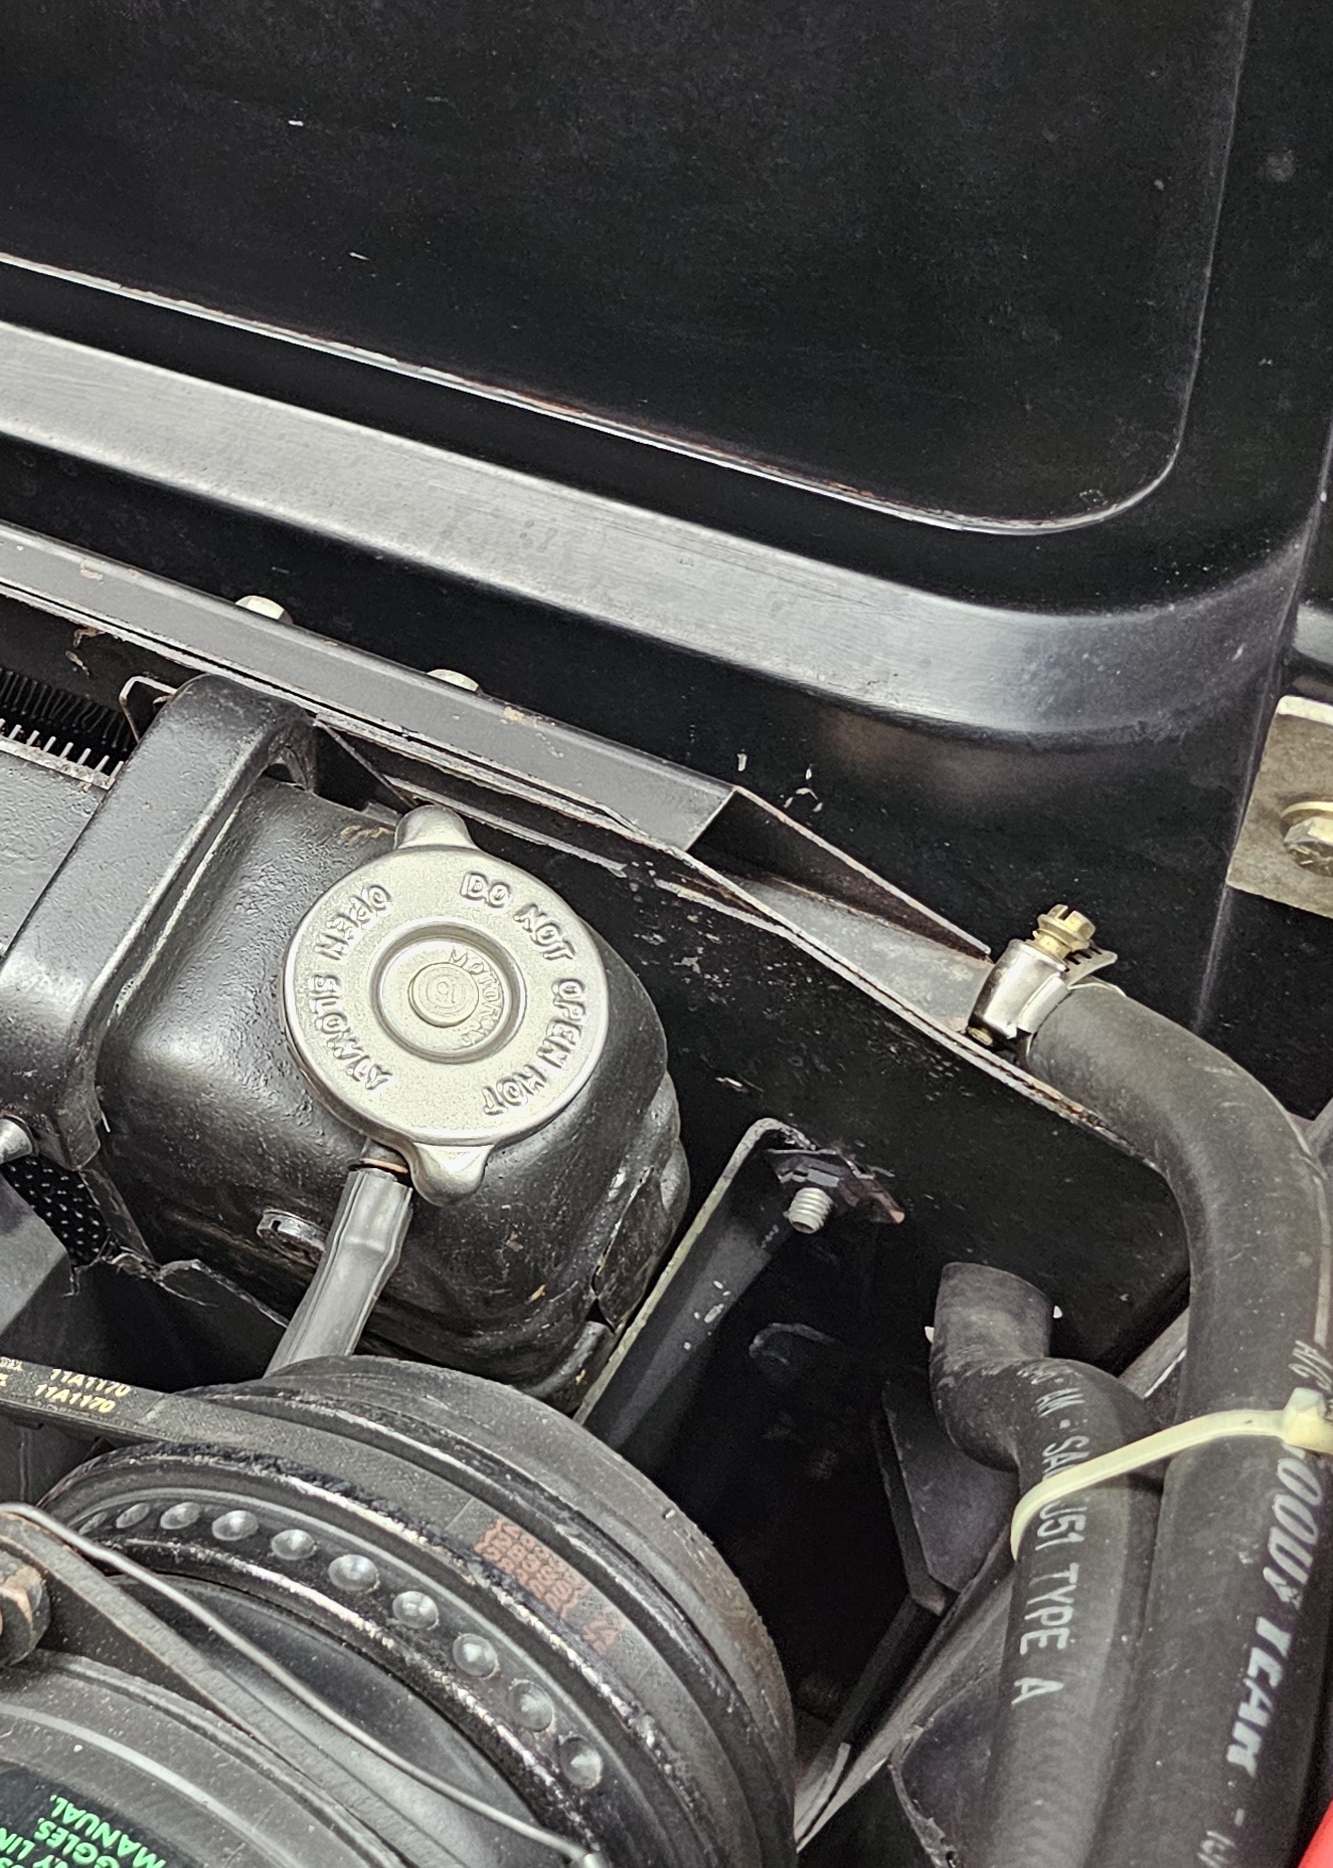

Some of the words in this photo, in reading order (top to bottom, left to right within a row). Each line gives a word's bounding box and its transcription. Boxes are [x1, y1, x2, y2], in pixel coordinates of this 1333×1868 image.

[460, 871, 513, 908] DO
[315, 884, 391, 960] OPEN
[513, 903, 577, 962] NOT
[309, 973, 393, 1090] SLOWLY
[538, 978, 587, 1070] OPEN
[483, 1061, 547, 1115] HOT
[34, 1384, 116, 1413] 11A1170
[1020, 1562, 1080, 1656] TYPE
[1010, 1677, 1065, 1706] A
